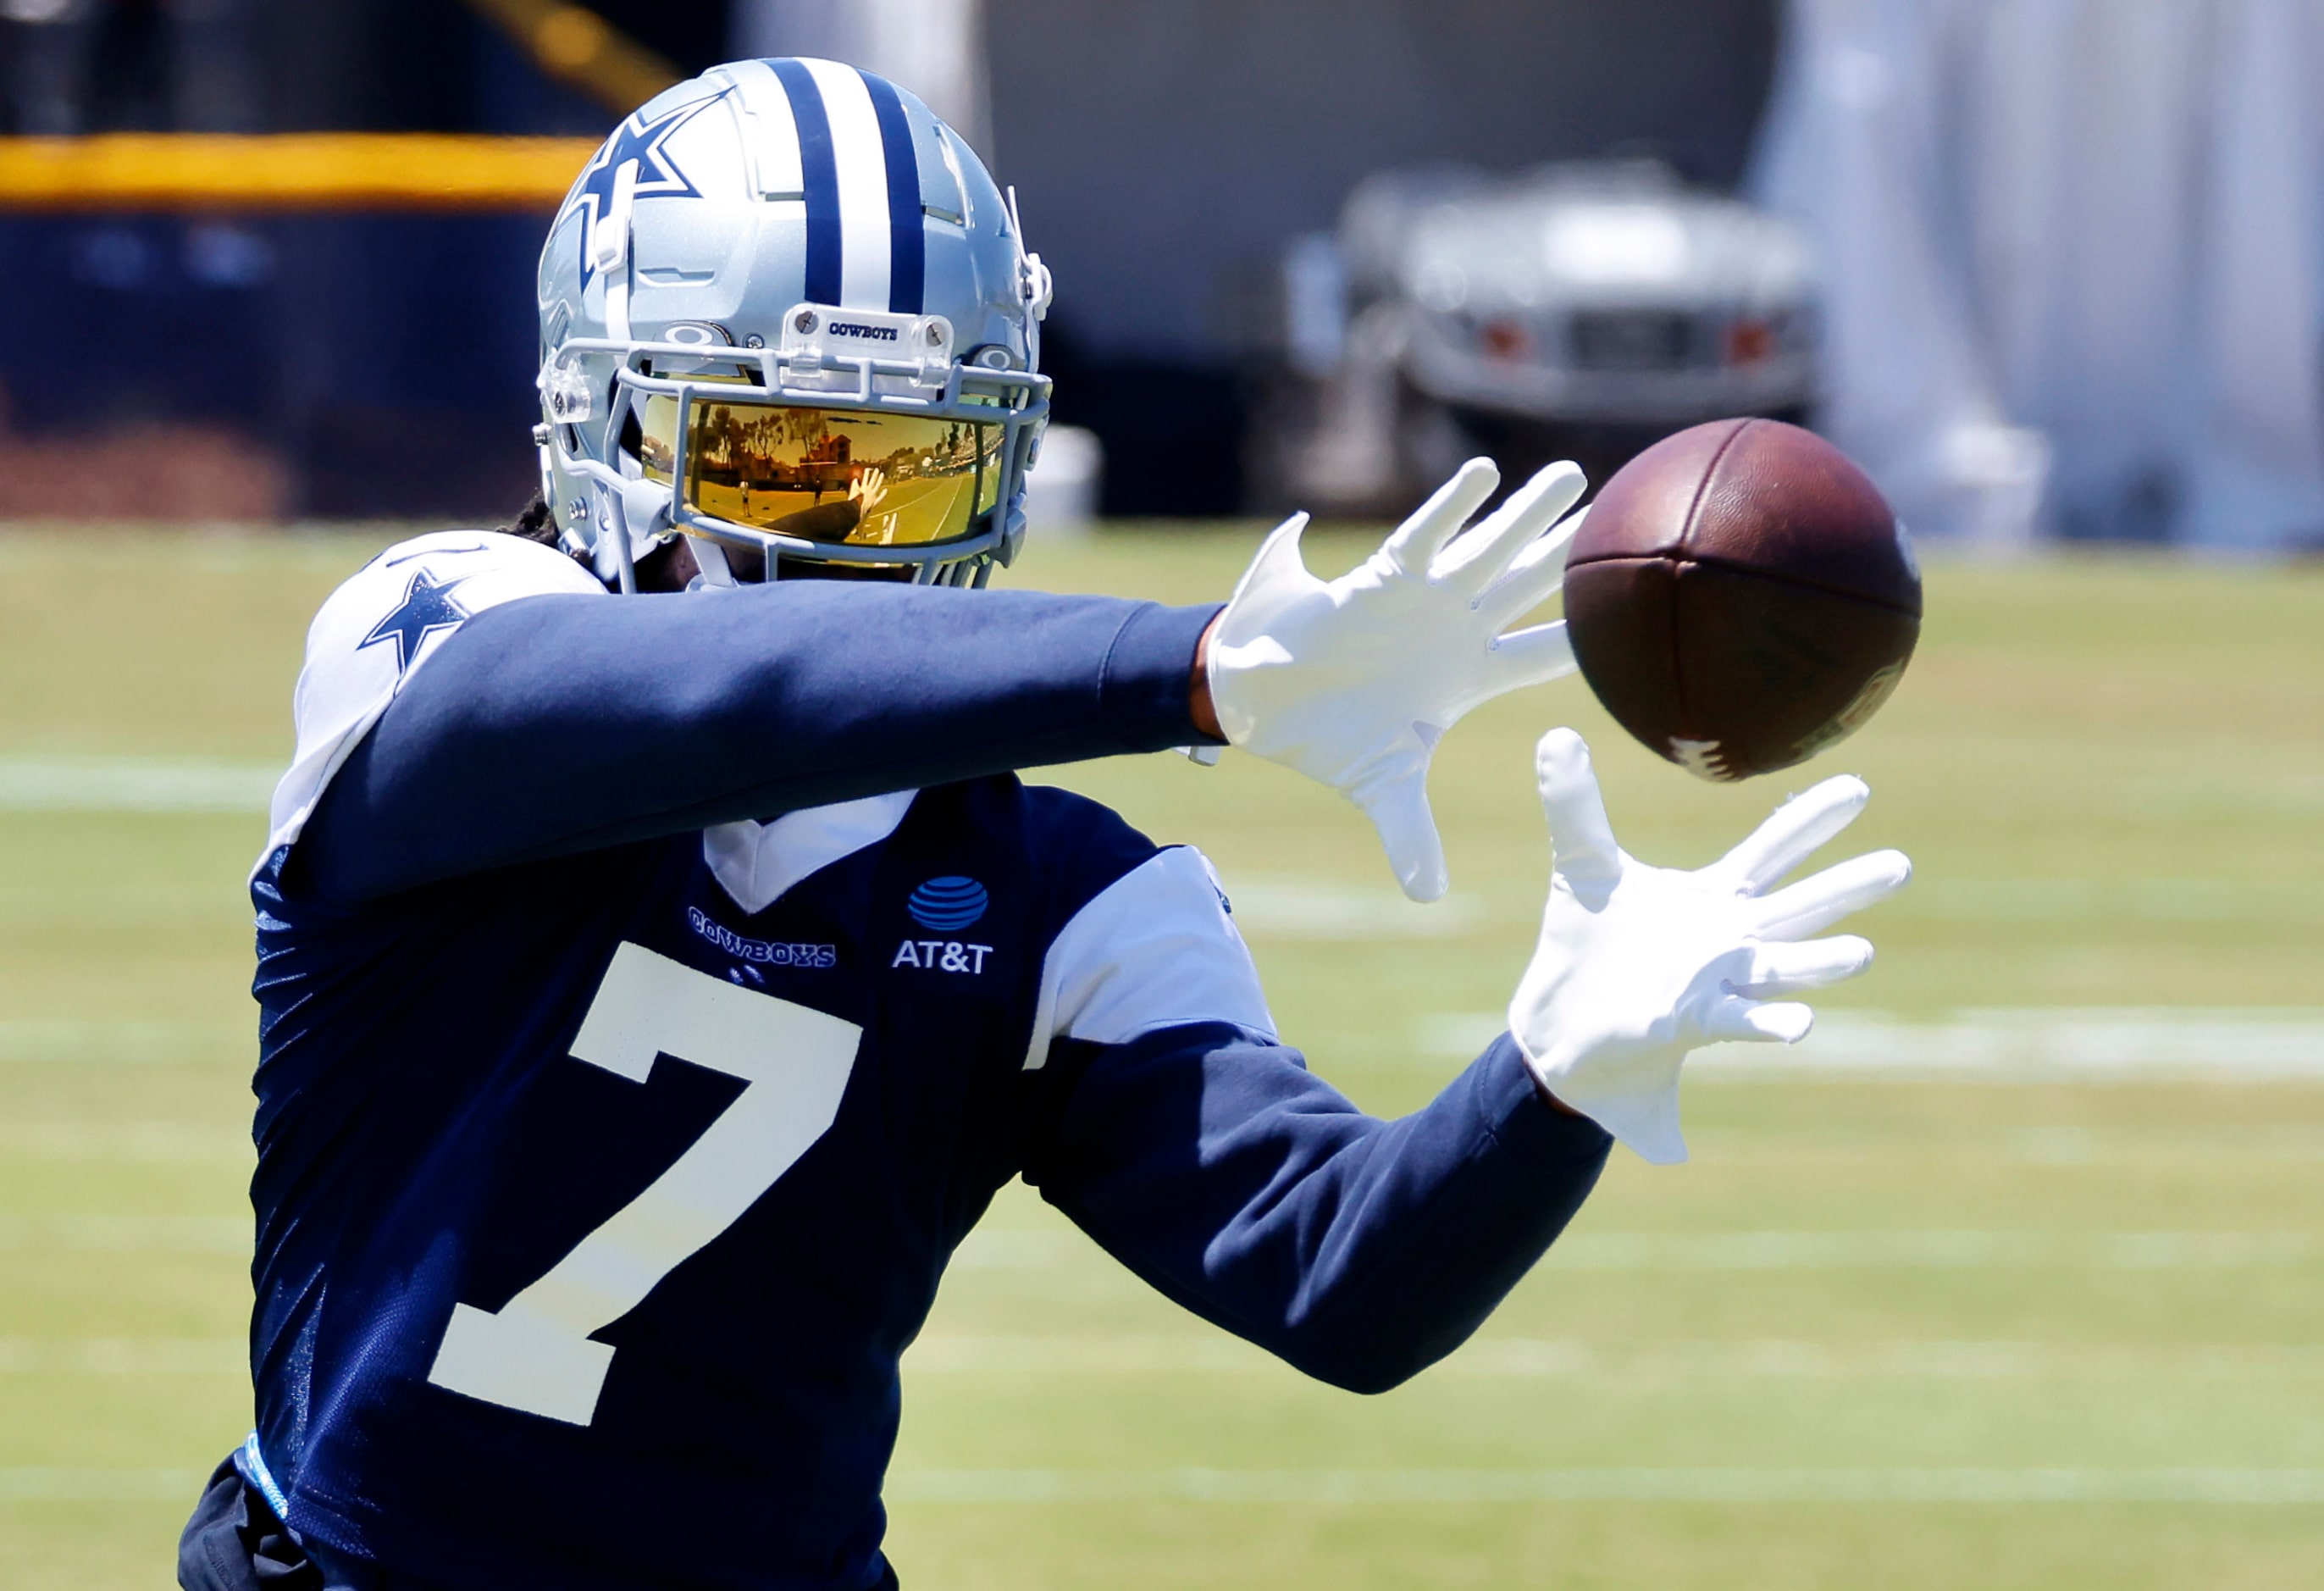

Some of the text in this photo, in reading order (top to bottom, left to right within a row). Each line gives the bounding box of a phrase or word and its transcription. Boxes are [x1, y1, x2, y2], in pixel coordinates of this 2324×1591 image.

[828, 322, 899, 341] COWBOYS
[689, 906, 837, 967] COWBOYS
[892, 940, 993, 974] AT&T
[427, 940, 864, 1427] 7
